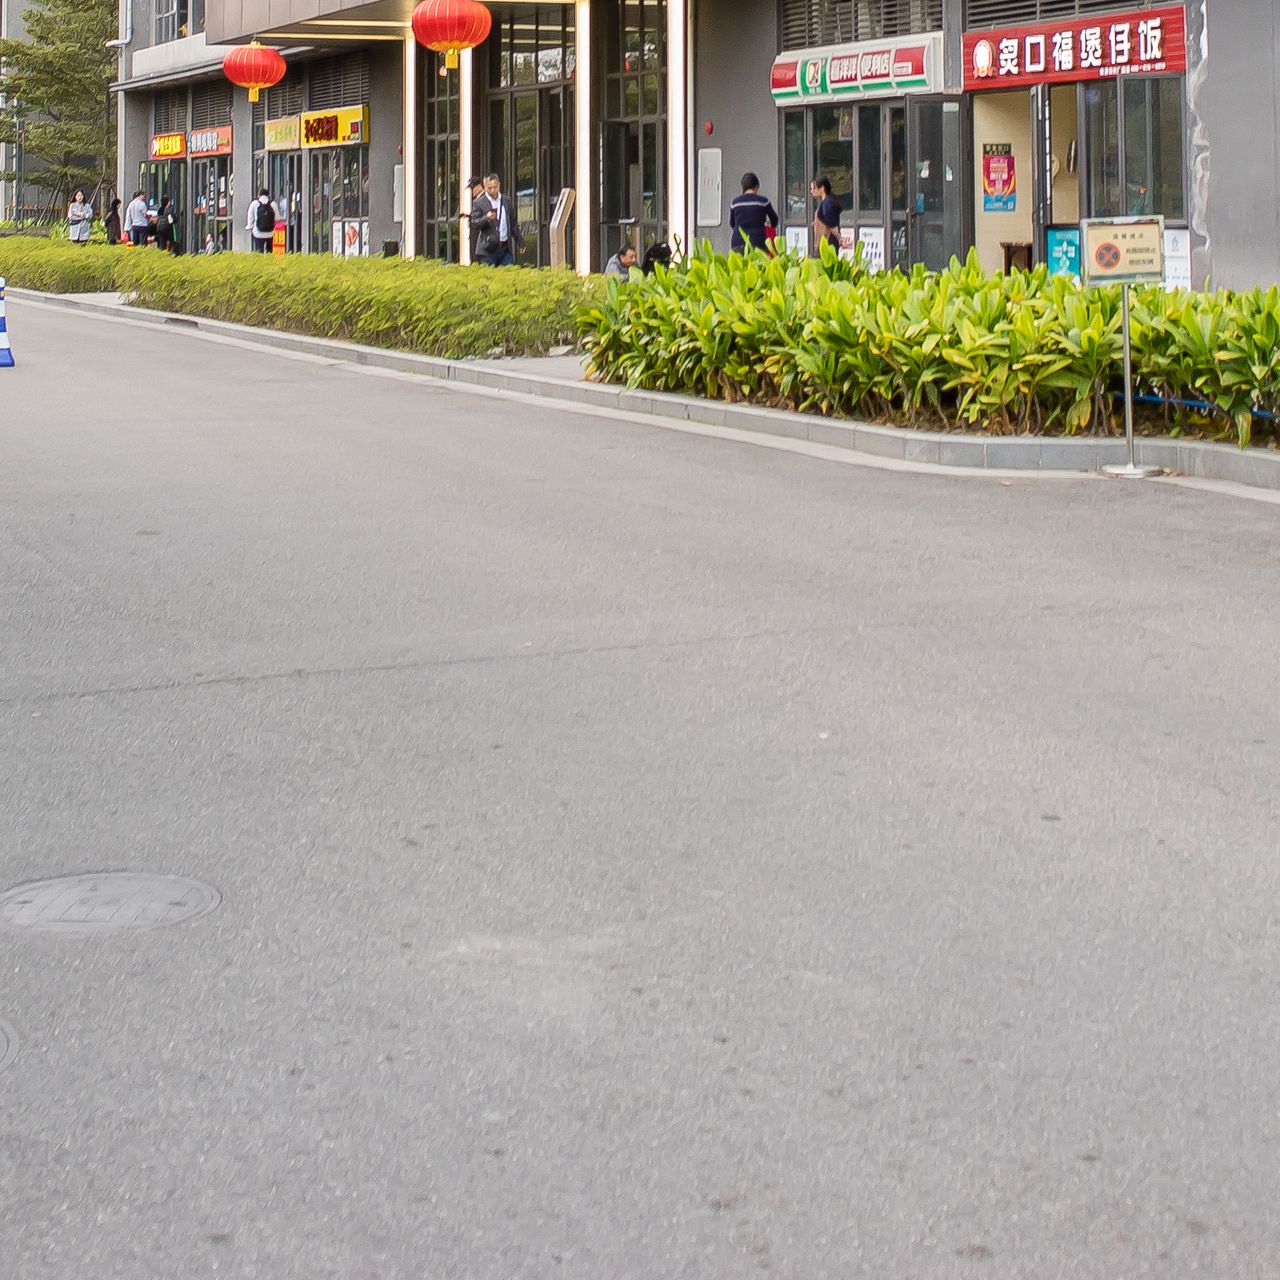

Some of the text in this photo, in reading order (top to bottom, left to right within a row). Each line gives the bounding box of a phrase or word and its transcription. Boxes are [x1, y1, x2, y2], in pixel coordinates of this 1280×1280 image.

[998, 16, 1164, 76] 炙口福煲仔饭
